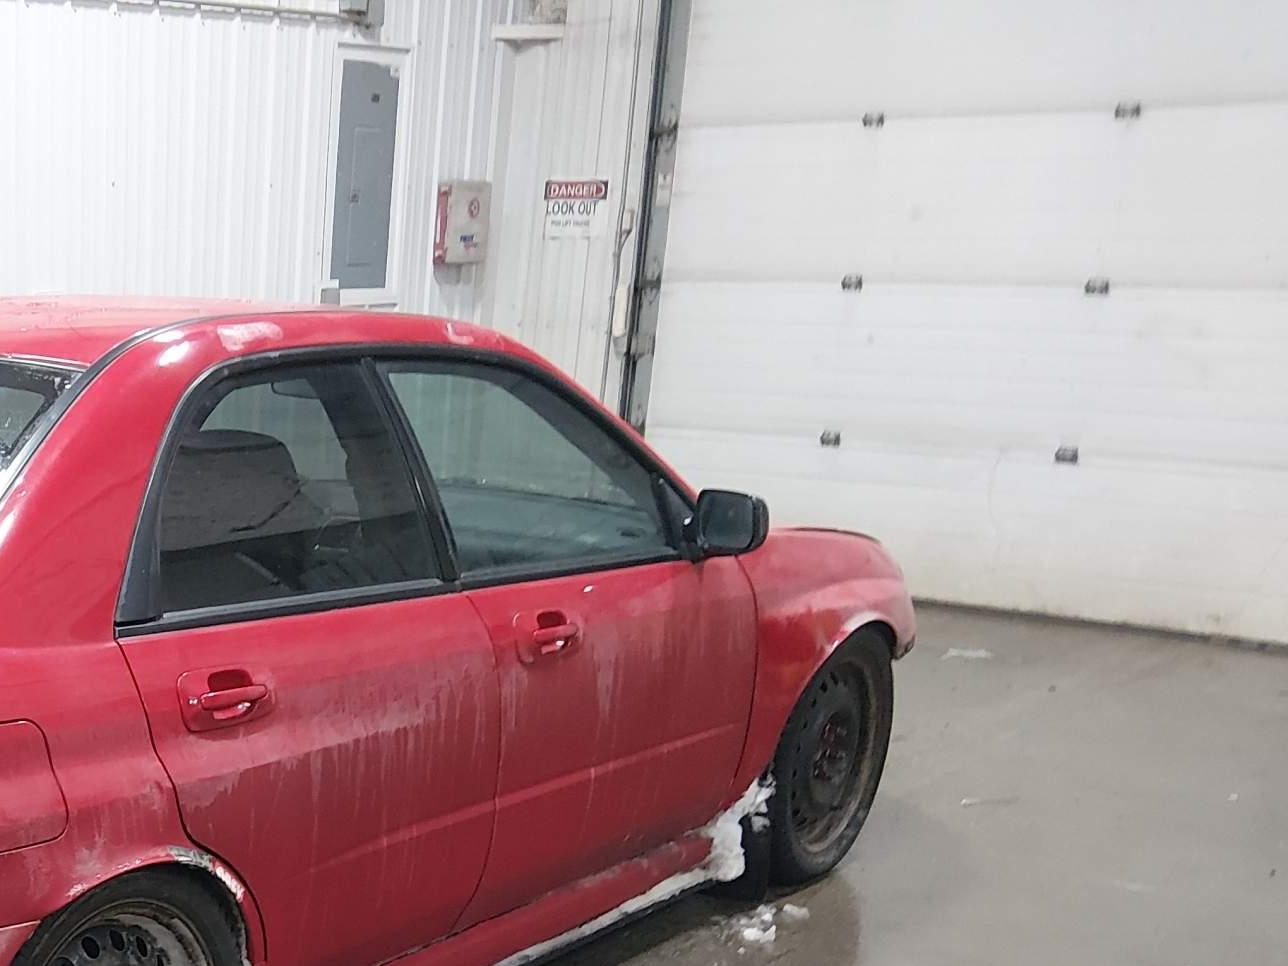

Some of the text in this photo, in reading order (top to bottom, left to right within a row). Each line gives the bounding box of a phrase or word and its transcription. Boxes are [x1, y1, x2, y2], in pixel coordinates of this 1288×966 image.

[550, 183, 597, 198] DANGER
[546, 200, 600, 216] LOOK OUT
